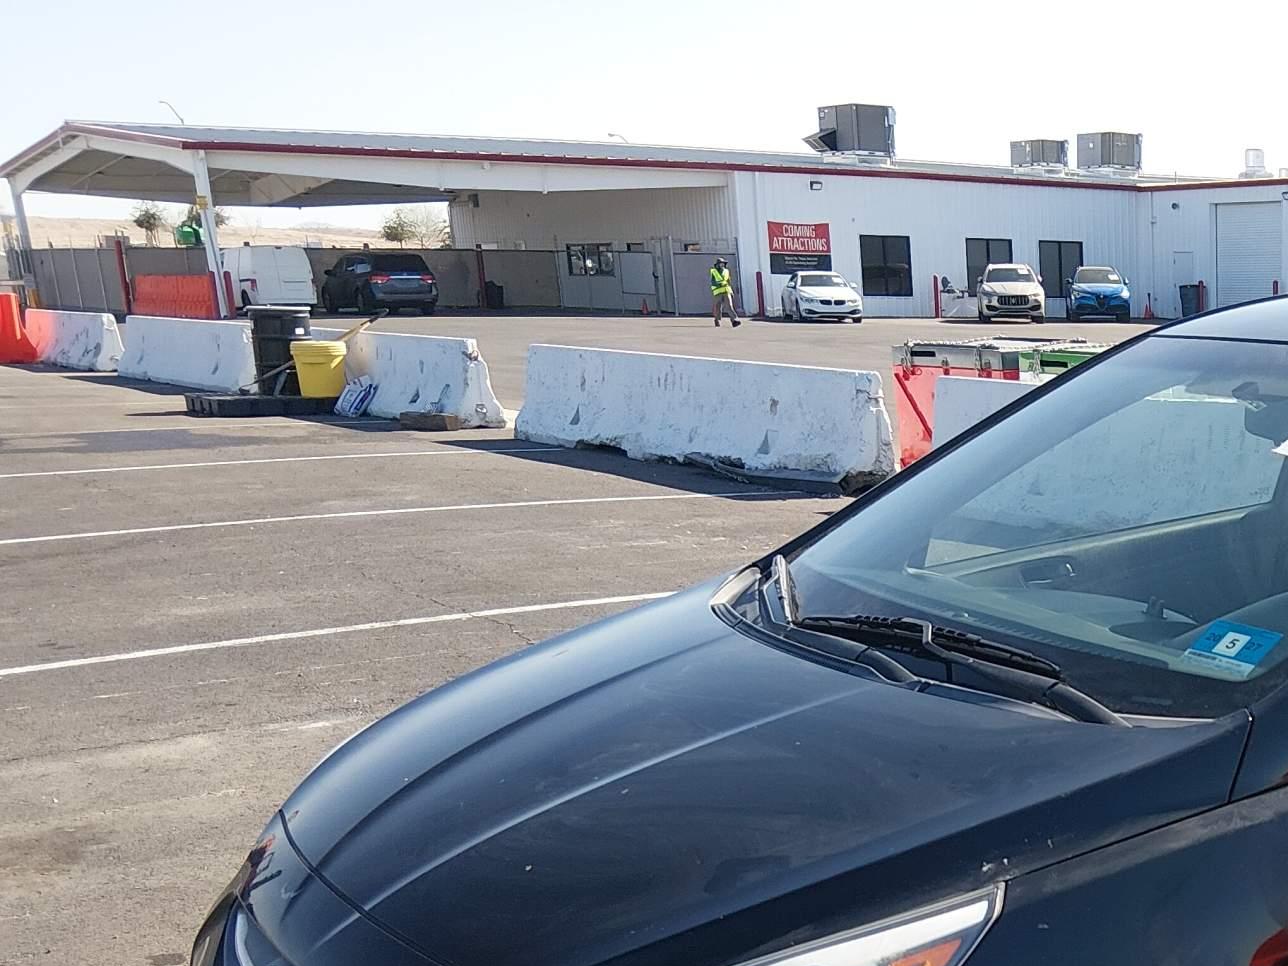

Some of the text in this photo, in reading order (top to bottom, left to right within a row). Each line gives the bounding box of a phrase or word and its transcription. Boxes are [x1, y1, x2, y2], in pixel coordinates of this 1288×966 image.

[782, 224, 816, 238] COMING
[772, 237, 828, 251] ATTRACTIONS
[1225, 638, 1240, 649] 5
